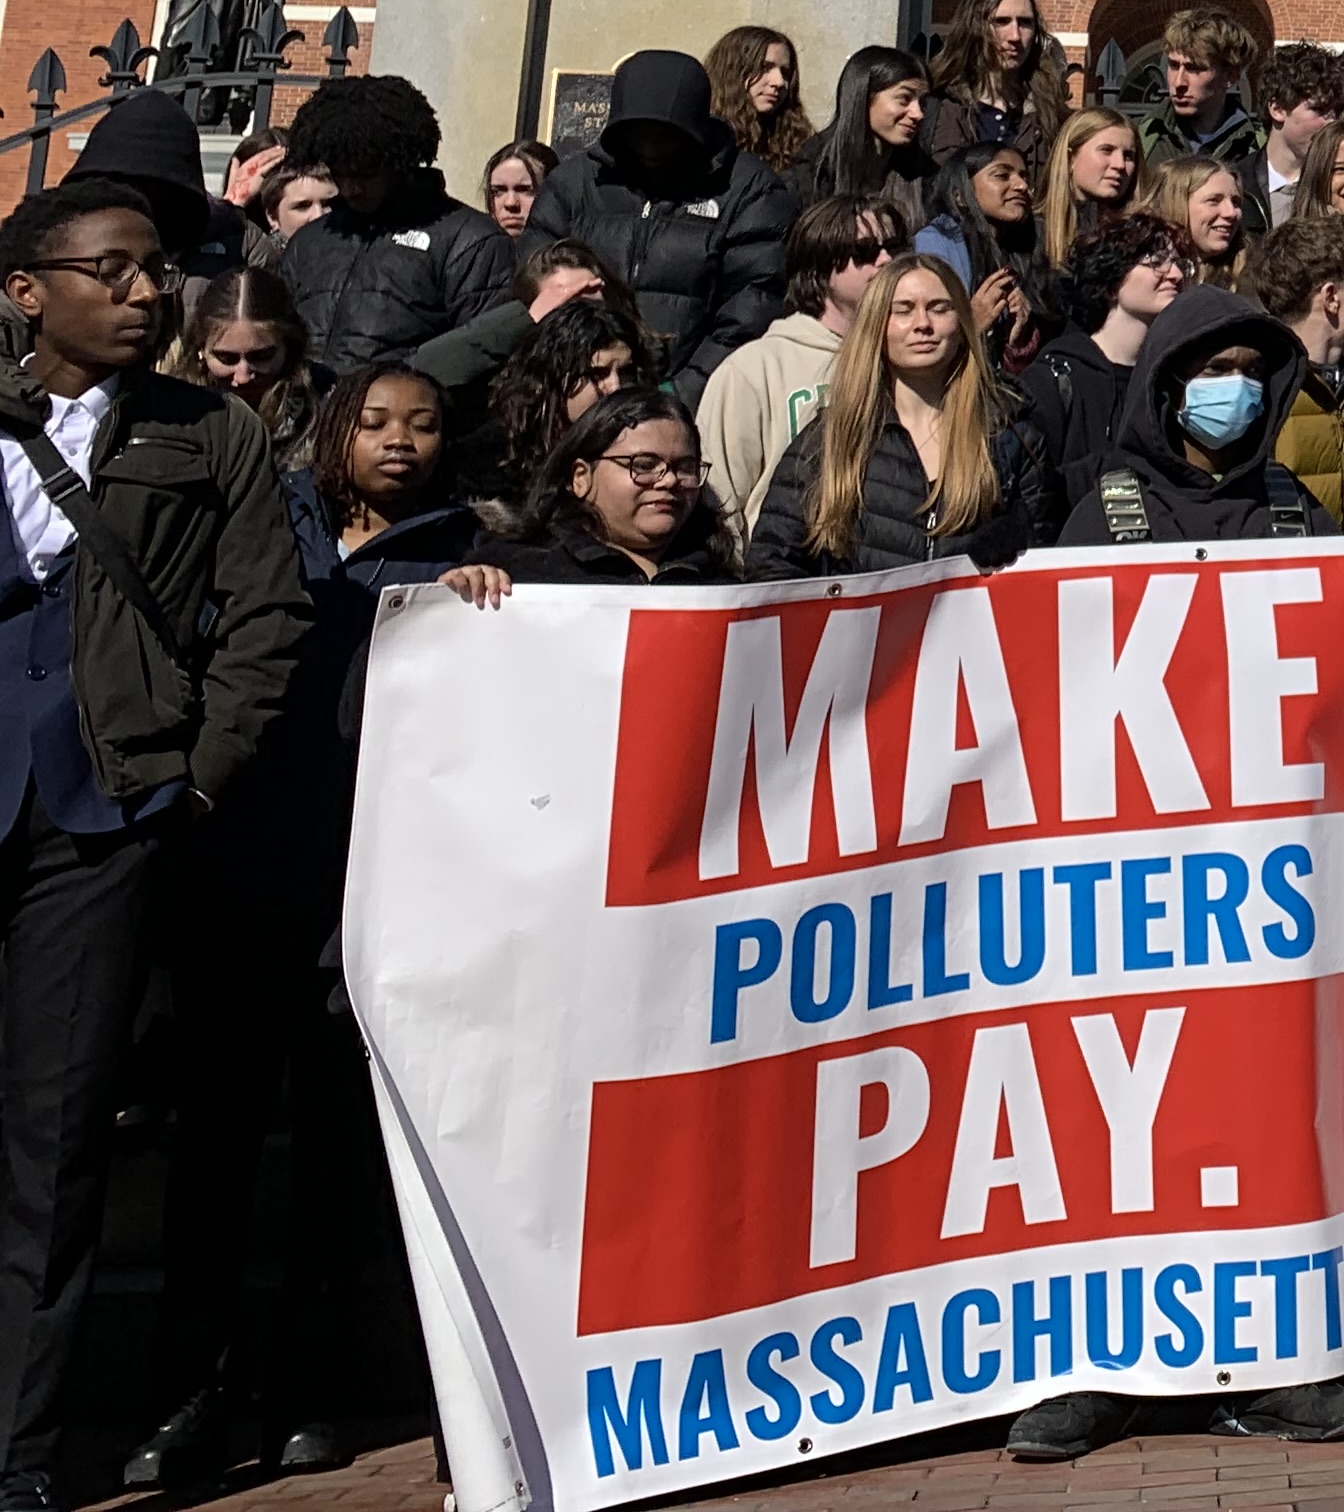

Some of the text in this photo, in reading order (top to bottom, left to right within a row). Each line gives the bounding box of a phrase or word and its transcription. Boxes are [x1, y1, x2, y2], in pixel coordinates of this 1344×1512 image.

[698, 571, 1326, 882] MAKE
[709, 843, 1318, 1046] POLLUTERS
[808, 1005, 1240, 1271] PAY.
